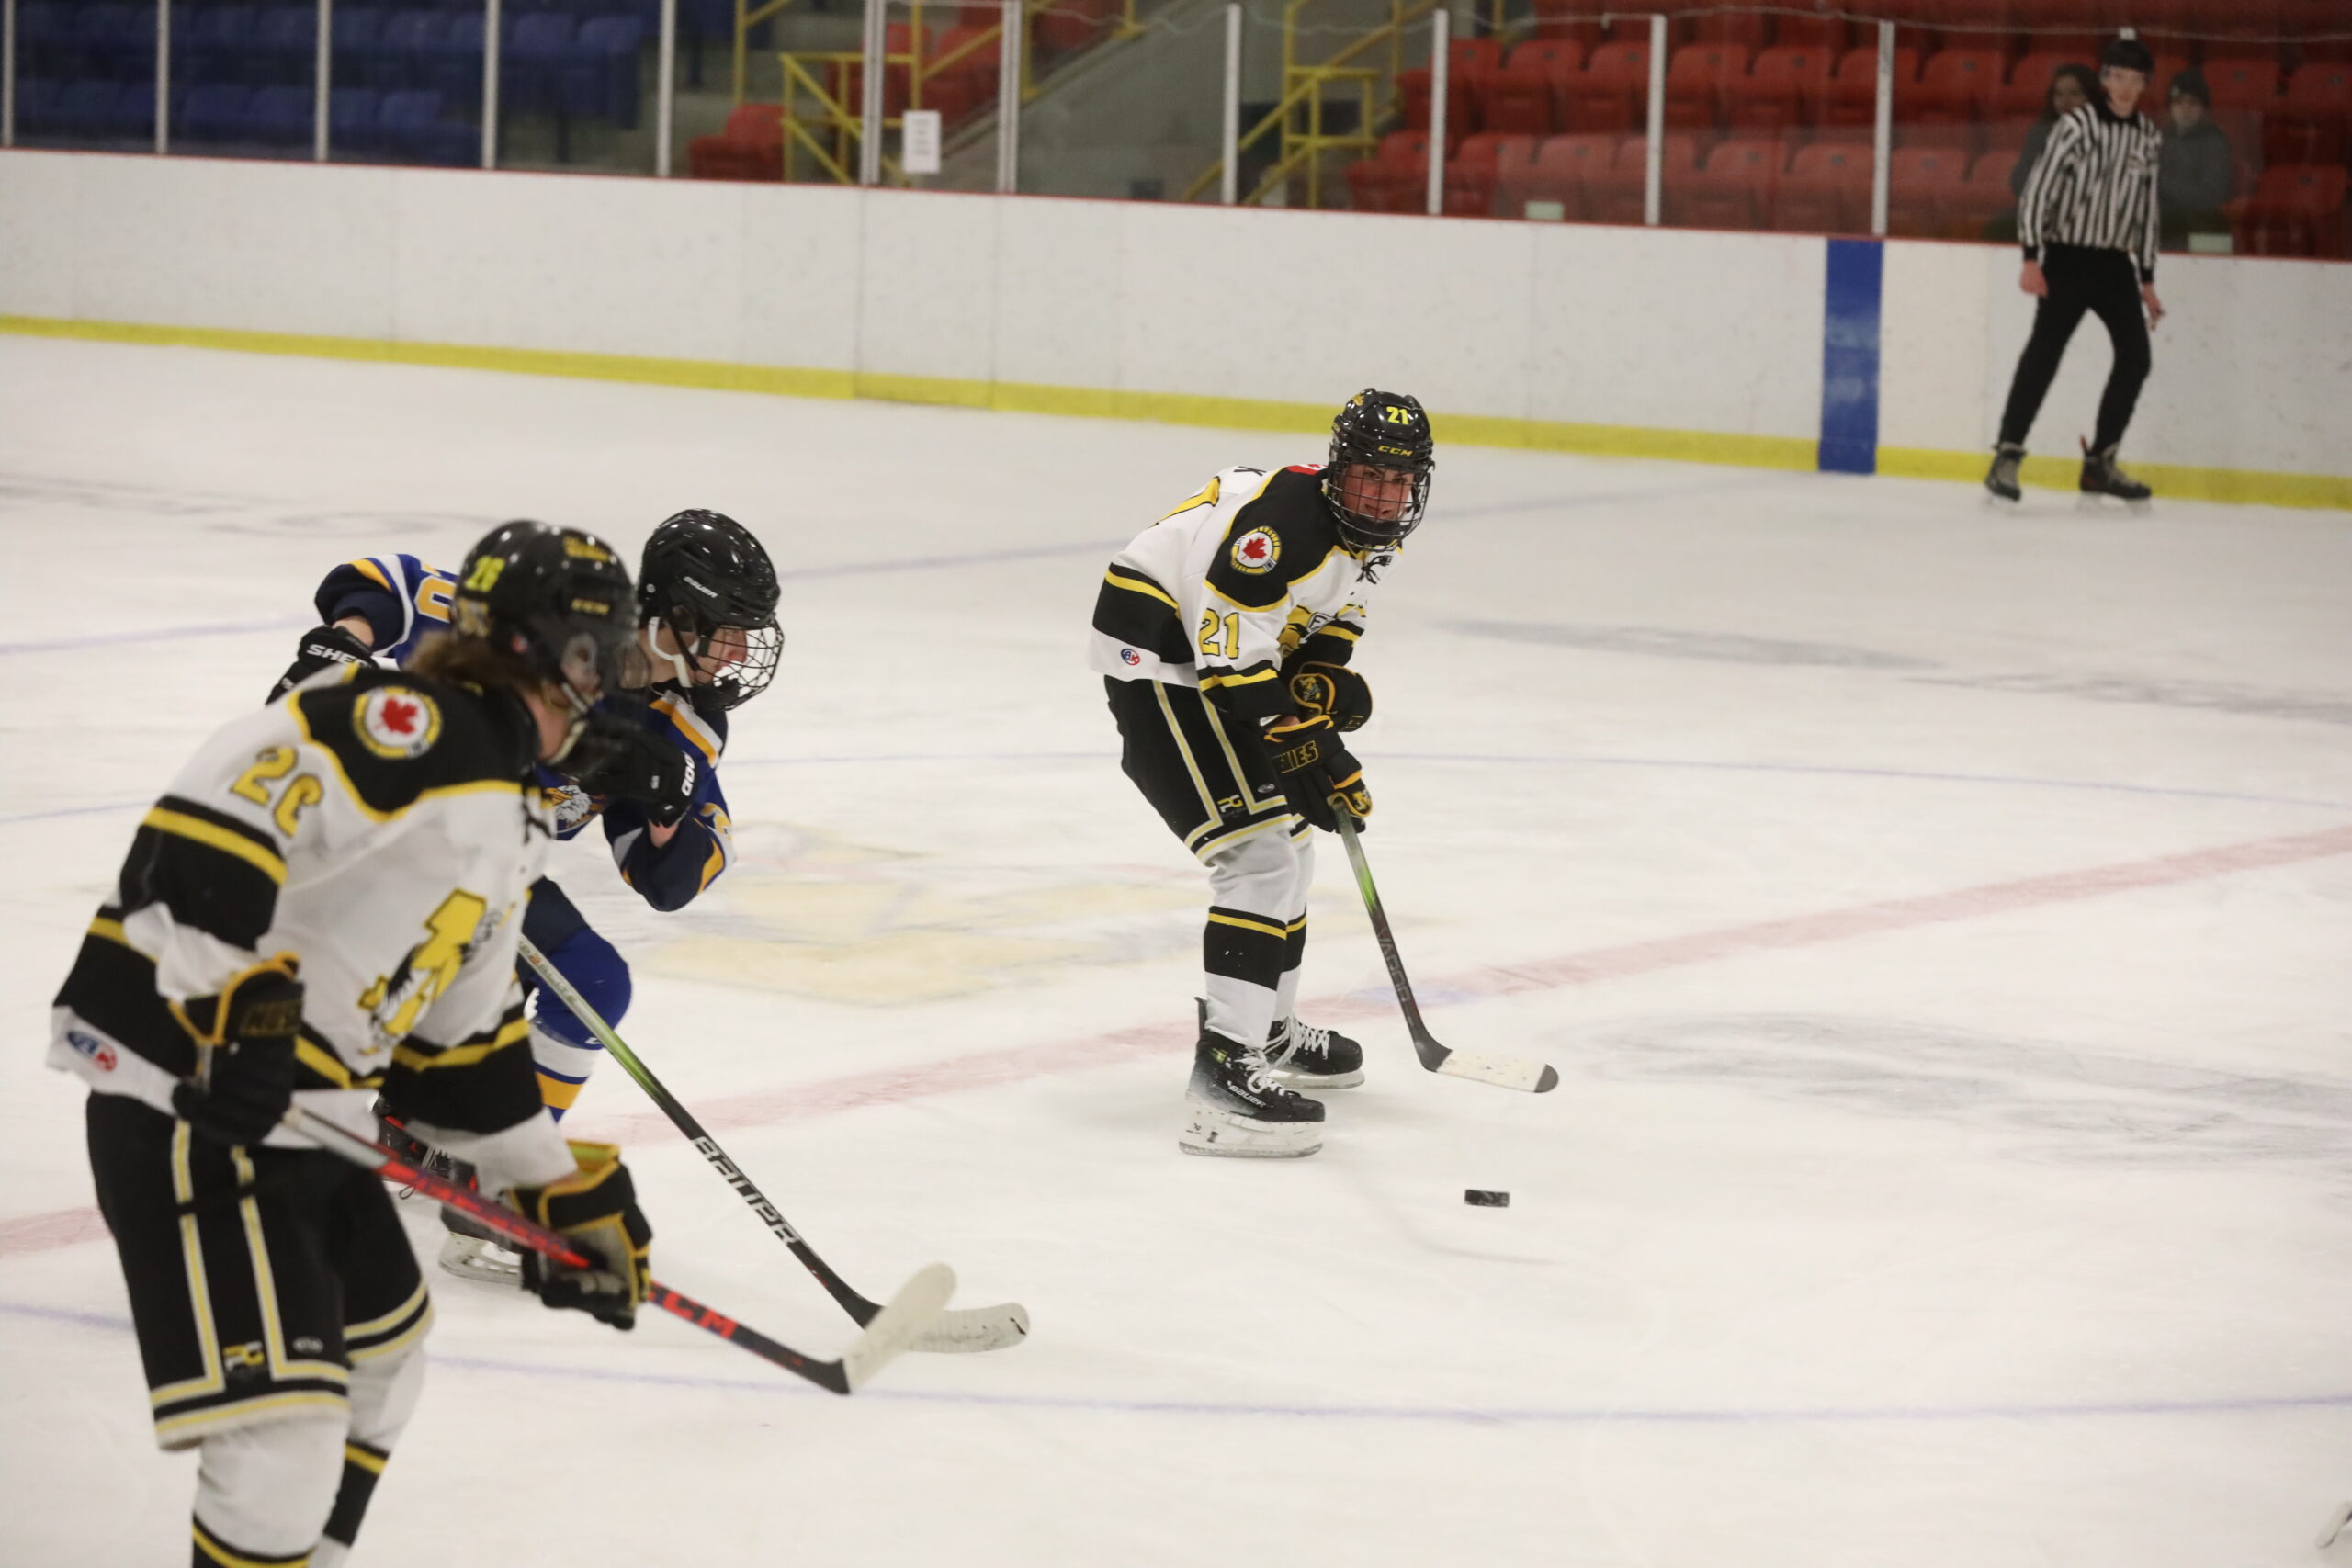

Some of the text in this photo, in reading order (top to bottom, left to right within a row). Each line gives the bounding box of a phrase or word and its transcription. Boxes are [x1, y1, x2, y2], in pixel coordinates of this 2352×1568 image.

[1385, 406, 1409, 424] 21
[1378, 445, 1413, 456] CCM
[1198, 607, 1239, 660] 21
[691, 1136, 803, 1246] BAUER
